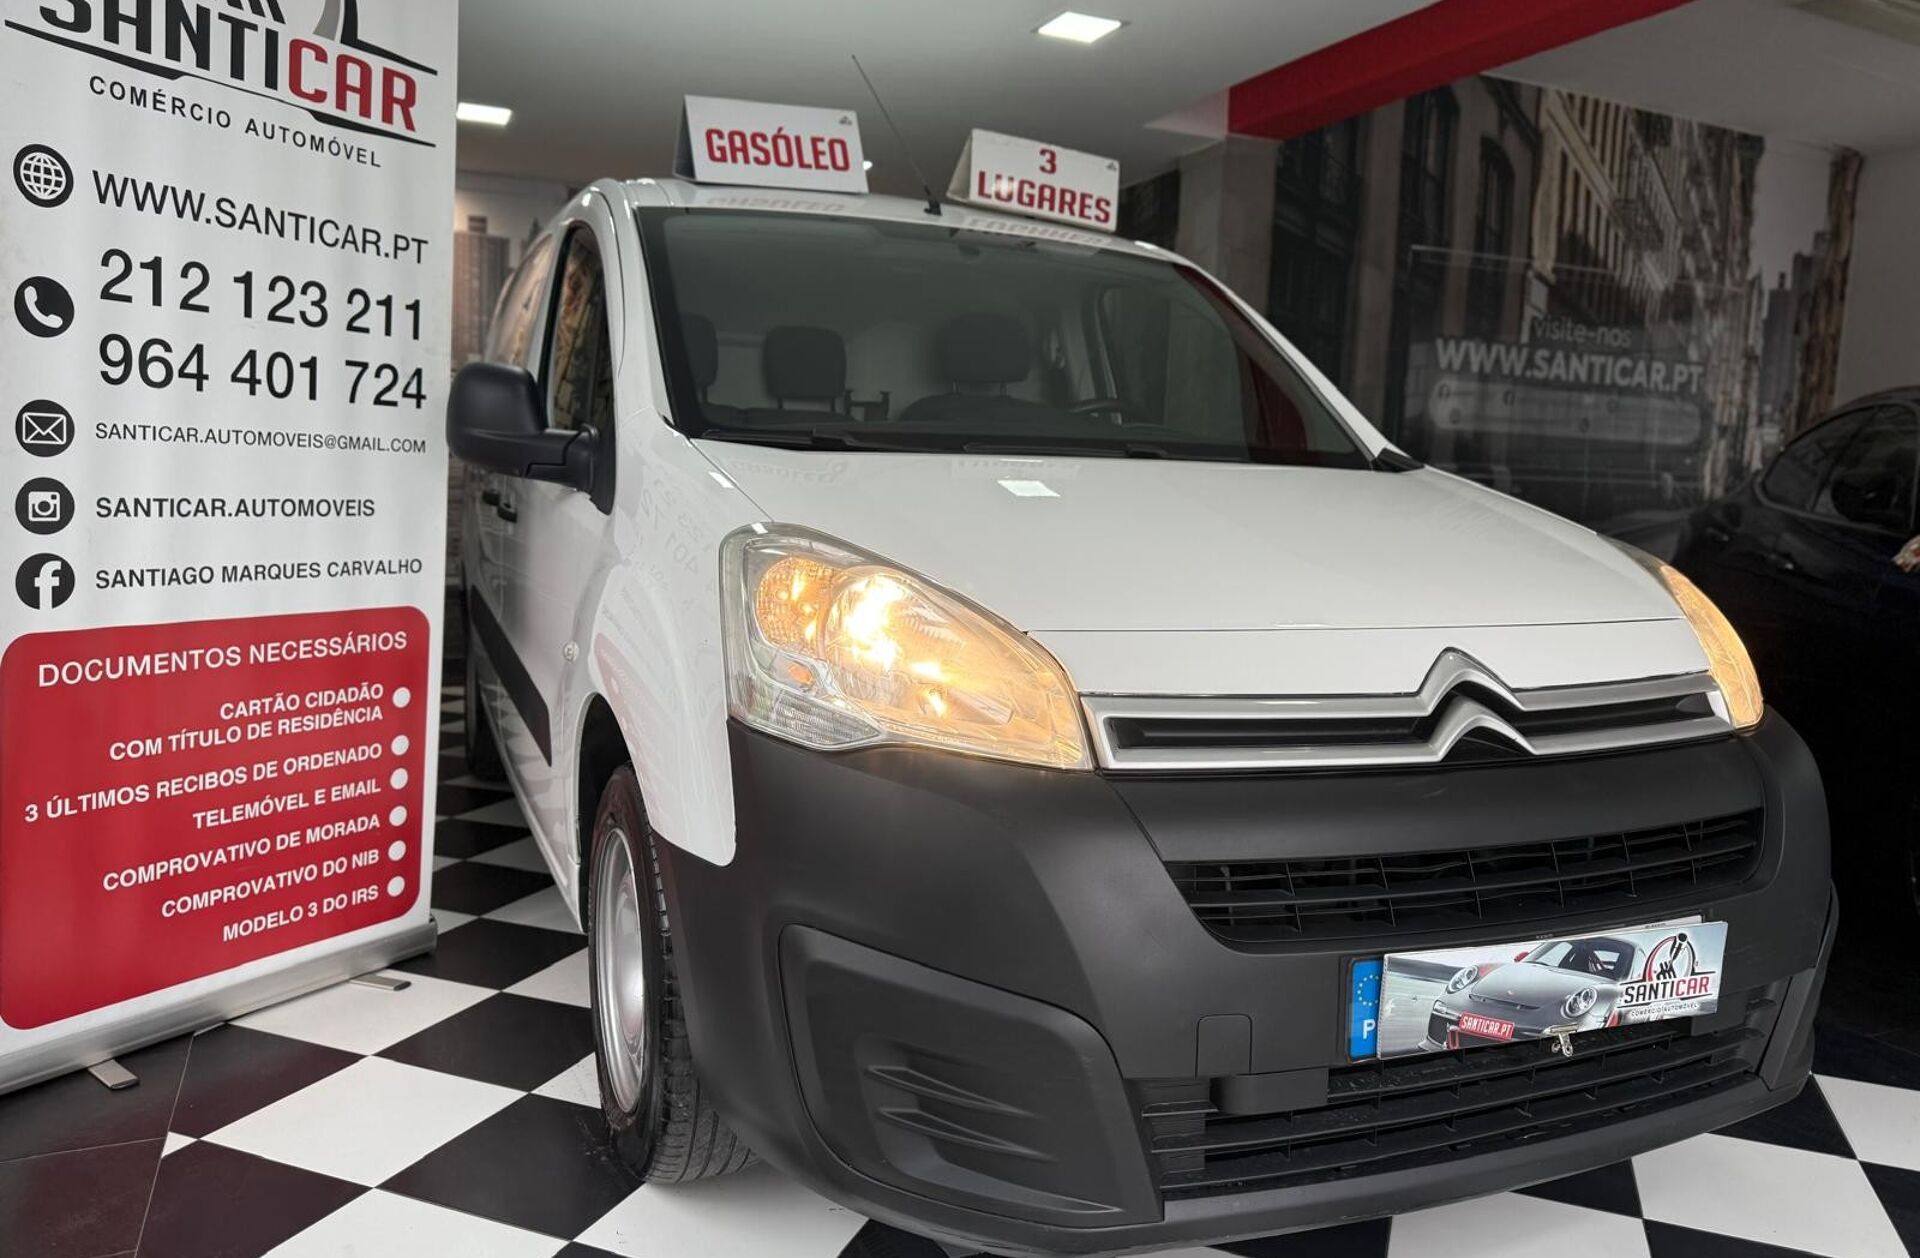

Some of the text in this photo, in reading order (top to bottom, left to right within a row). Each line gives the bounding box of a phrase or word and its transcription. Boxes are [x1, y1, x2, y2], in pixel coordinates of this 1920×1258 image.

[89, 75, 381, 168] COMÉRCIO AUTOMÓVEL
[706, 126, 850, 172] GASÓLEO
[1039, 148, 1057, 175] 3
[92, 169, 429, 264] WWW.SANTICAR.PT
[978, 170, 1111, 224] LUGARES
[100, 248, 420, 341] 212 123 211
[1533, 315, 1633, 349] visite-nos
[99, 334, 427, 409] 964 401 724
[1436, 338, 1704, 394] WWW.SANTICAR.PT
[95, 423, 427, 454] SANTICAR.AUTOMOVEIS@GMAIL.COM
[96, 496, 376, 519] SANTICAR.AUTOMOVEIS
[95, 558, 423, 589] SANTIAGO MARQUES CARVALHO
[38, 631, 408, 687] DOCUMENTOS NECESSÁRIOS
[220, 682, 384, 721] CARTÃO CIDADÃO
[109, 705, 383, 761] COM TÍTULO DE RESIDÊNCIA
[24, 743, 382, 823] 3 ÚLTIMOS RECIBOS DE ORDENADO
[193, 779, 381, 829] TELEMÓVEL E EMAIL
[103, 813, 380, 892] COMPROVATIVO DE MORADA
[161, 848, 380, 918] COMPROVATIVO DO NIB
[223, 885, 379, 943] MODELO 3 DO IRS
[1624, 976, 1709, 1004] SANTICAR
[1363, 1019, 1376, 1040] P
[1461, 1016, 1512, 1037] SANTICAR.PT
